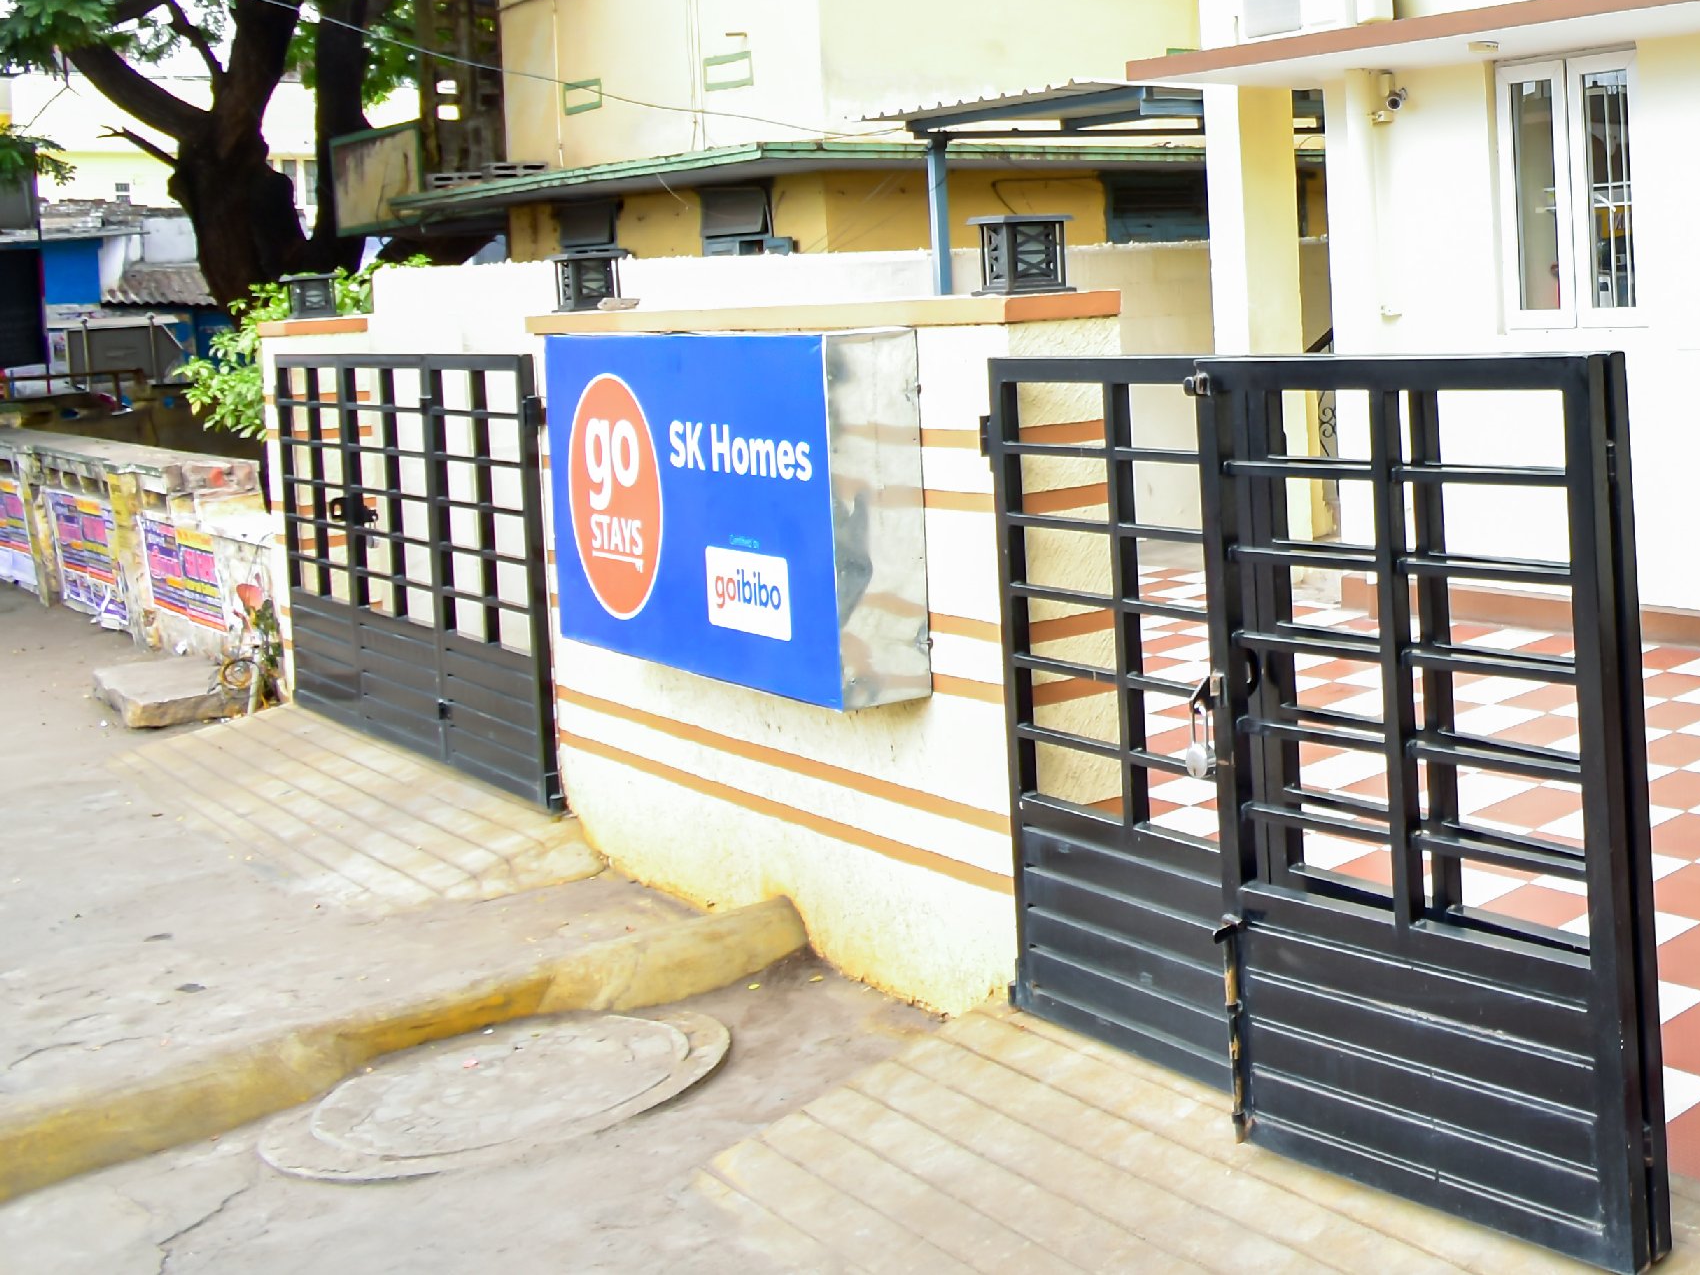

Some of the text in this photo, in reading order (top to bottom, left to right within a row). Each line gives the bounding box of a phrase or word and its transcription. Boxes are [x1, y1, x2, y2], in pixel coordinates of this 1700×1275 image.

[585, 417, 640, 511] go
[669, 420, 813, 482] SK Homes
[591, 514, 643, 555] STAYS
[714, 569, 782, 612] goibibo
